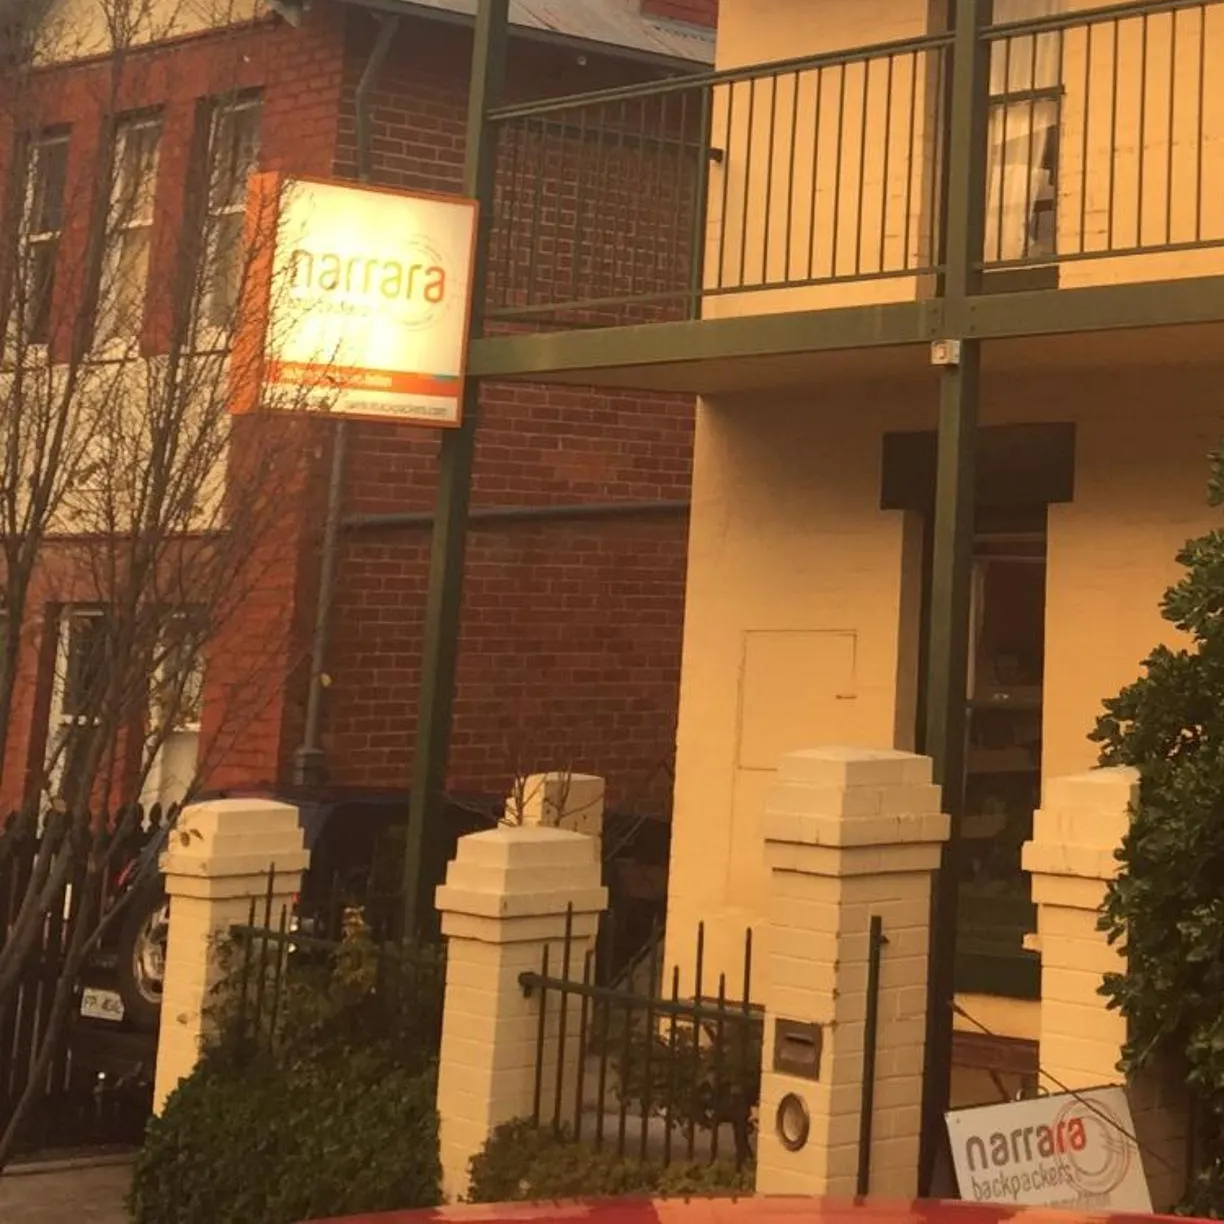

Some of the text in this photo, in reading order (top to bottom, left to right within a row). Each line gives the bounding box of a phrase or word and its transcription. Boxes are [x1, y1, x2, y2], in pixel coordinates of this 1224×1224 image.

[291, 249, 446, 304] narrara
[965, 1117, 1087, 1172] narrara
[972, 1163, 1073, 1201] backpackers
